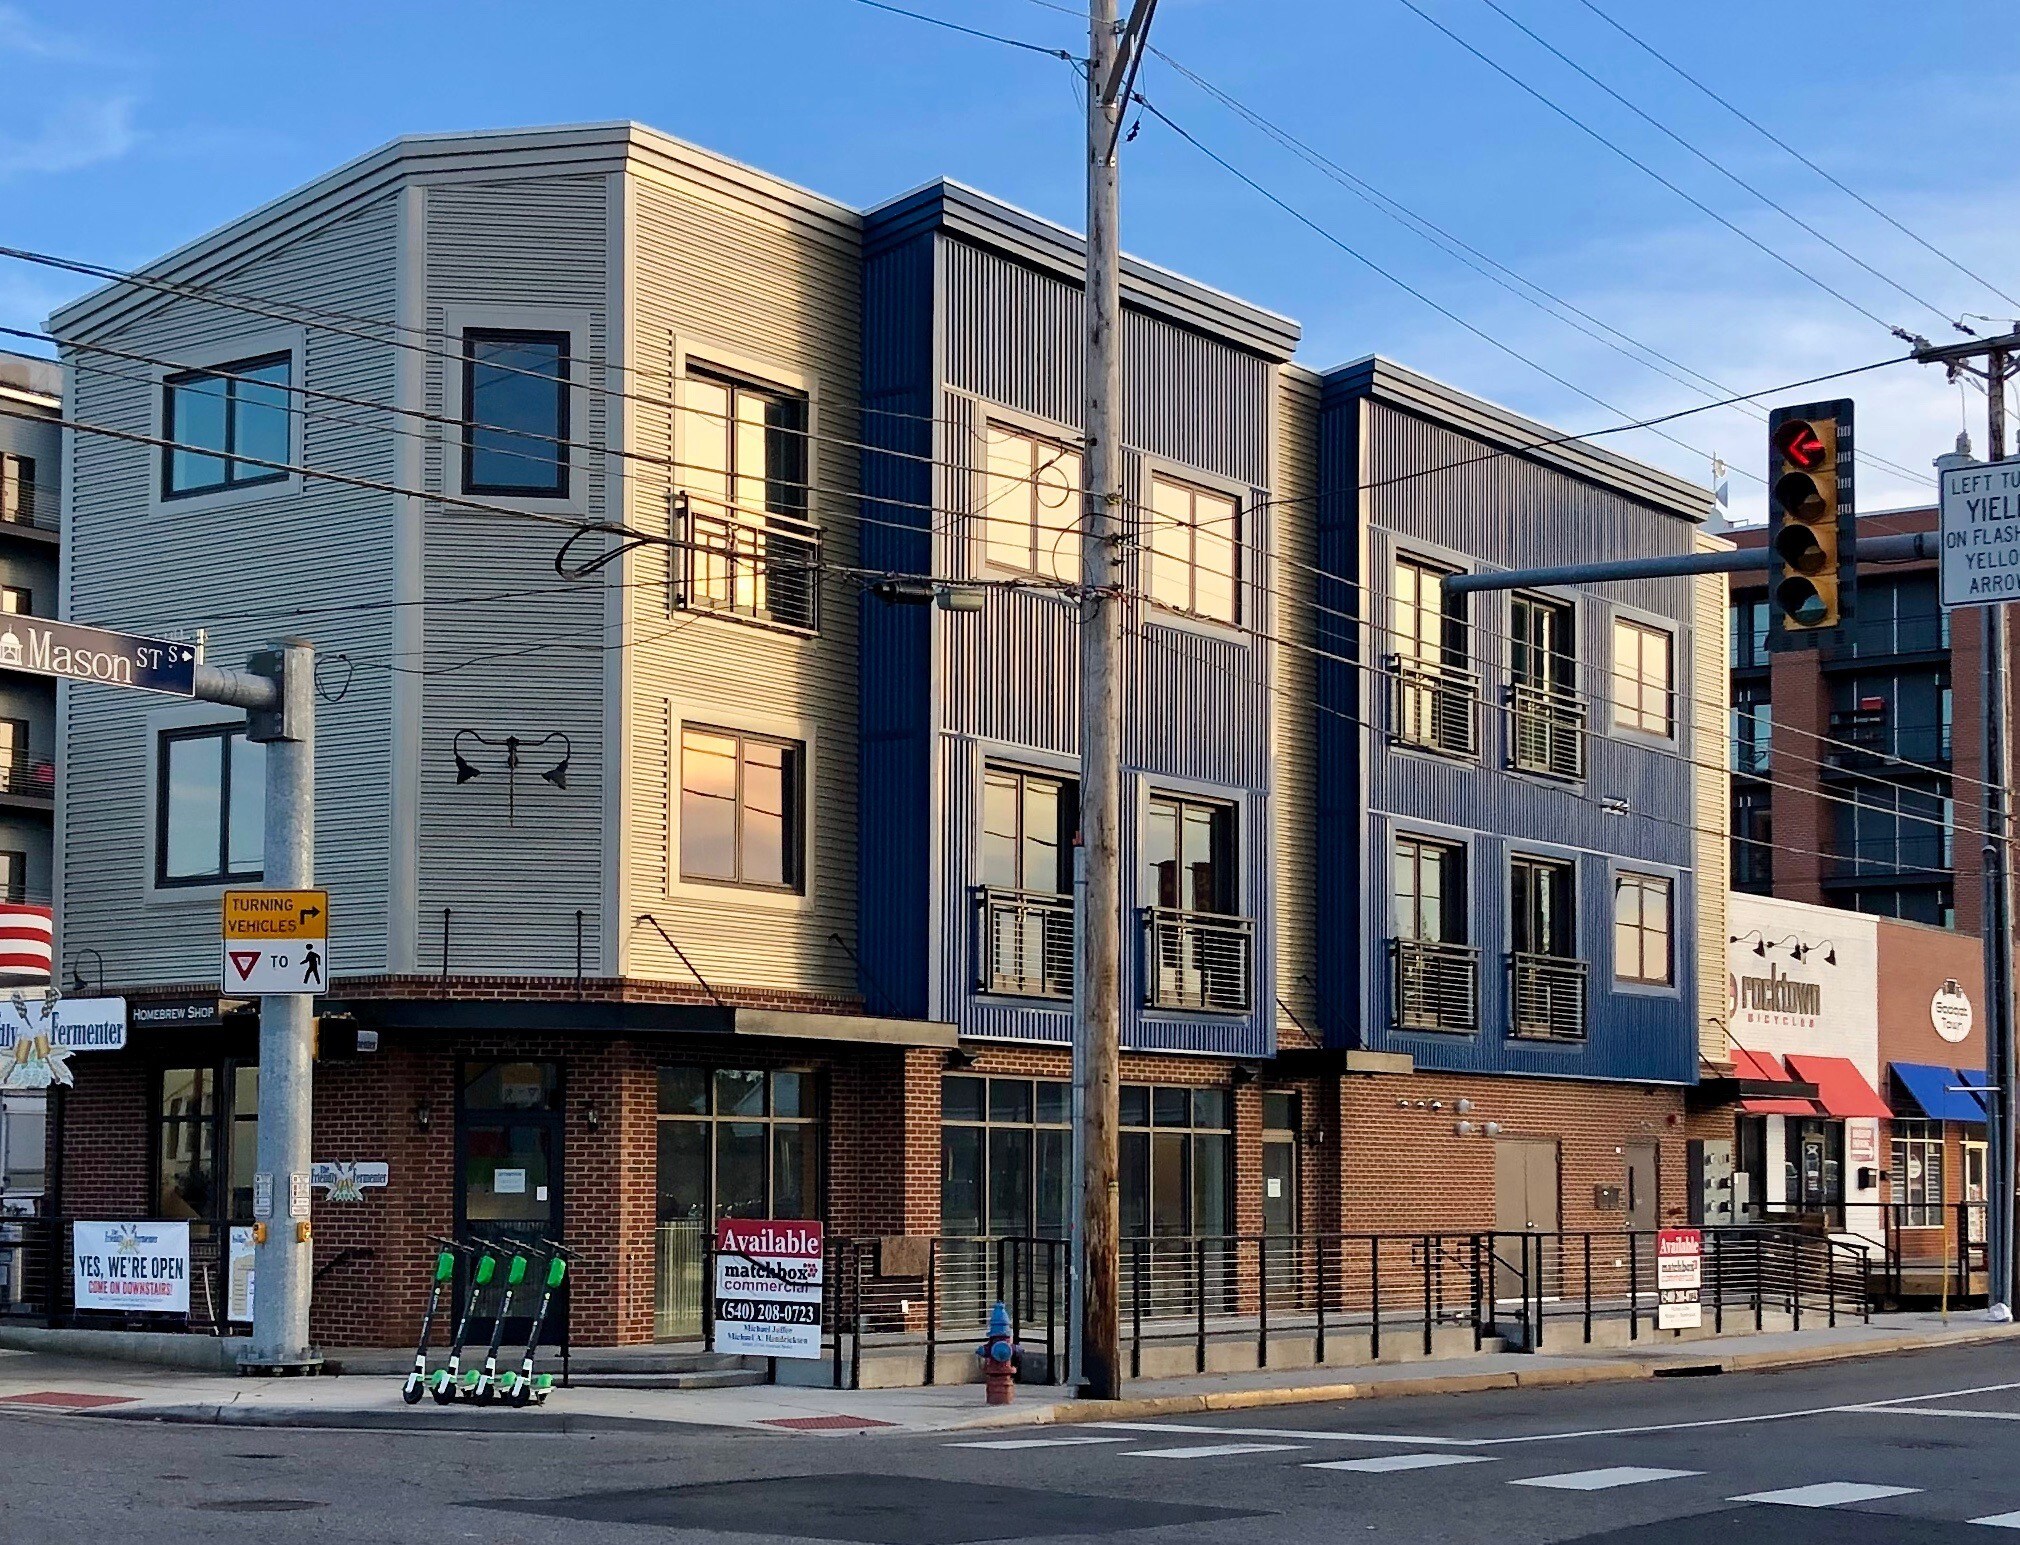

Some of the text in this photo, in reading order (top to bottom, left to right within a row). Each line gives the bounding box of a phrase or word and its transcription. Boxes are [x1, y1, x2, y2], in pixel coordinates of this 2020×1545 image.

[1951, 474, 1992, 496] LEFT
[1946, 531, 1967, 549] ON
[27, 628, 133, 684] Mason
[136, 647, 163, 670] ST
[232, 898, 294, 911] TURNING
[228, 919, 297, 933] VEHICLES
[270, 955, 289, 968] TO
[133, 1006, 214, 1020] HOMEBREW SHOP
[51, 1011, 124, 1046] Fermenter
[721, 1228, 819, 1255] Available
[79, 1256, 184, 1280] YES, WE'RE OPEN
[724, 1261, 808, 1281] matchbox
[88, 1281, 108, 1294] COME
[110, 1281, 120, 1295] ON
[722, 1300, 814, 1323] (540) 208-0723
